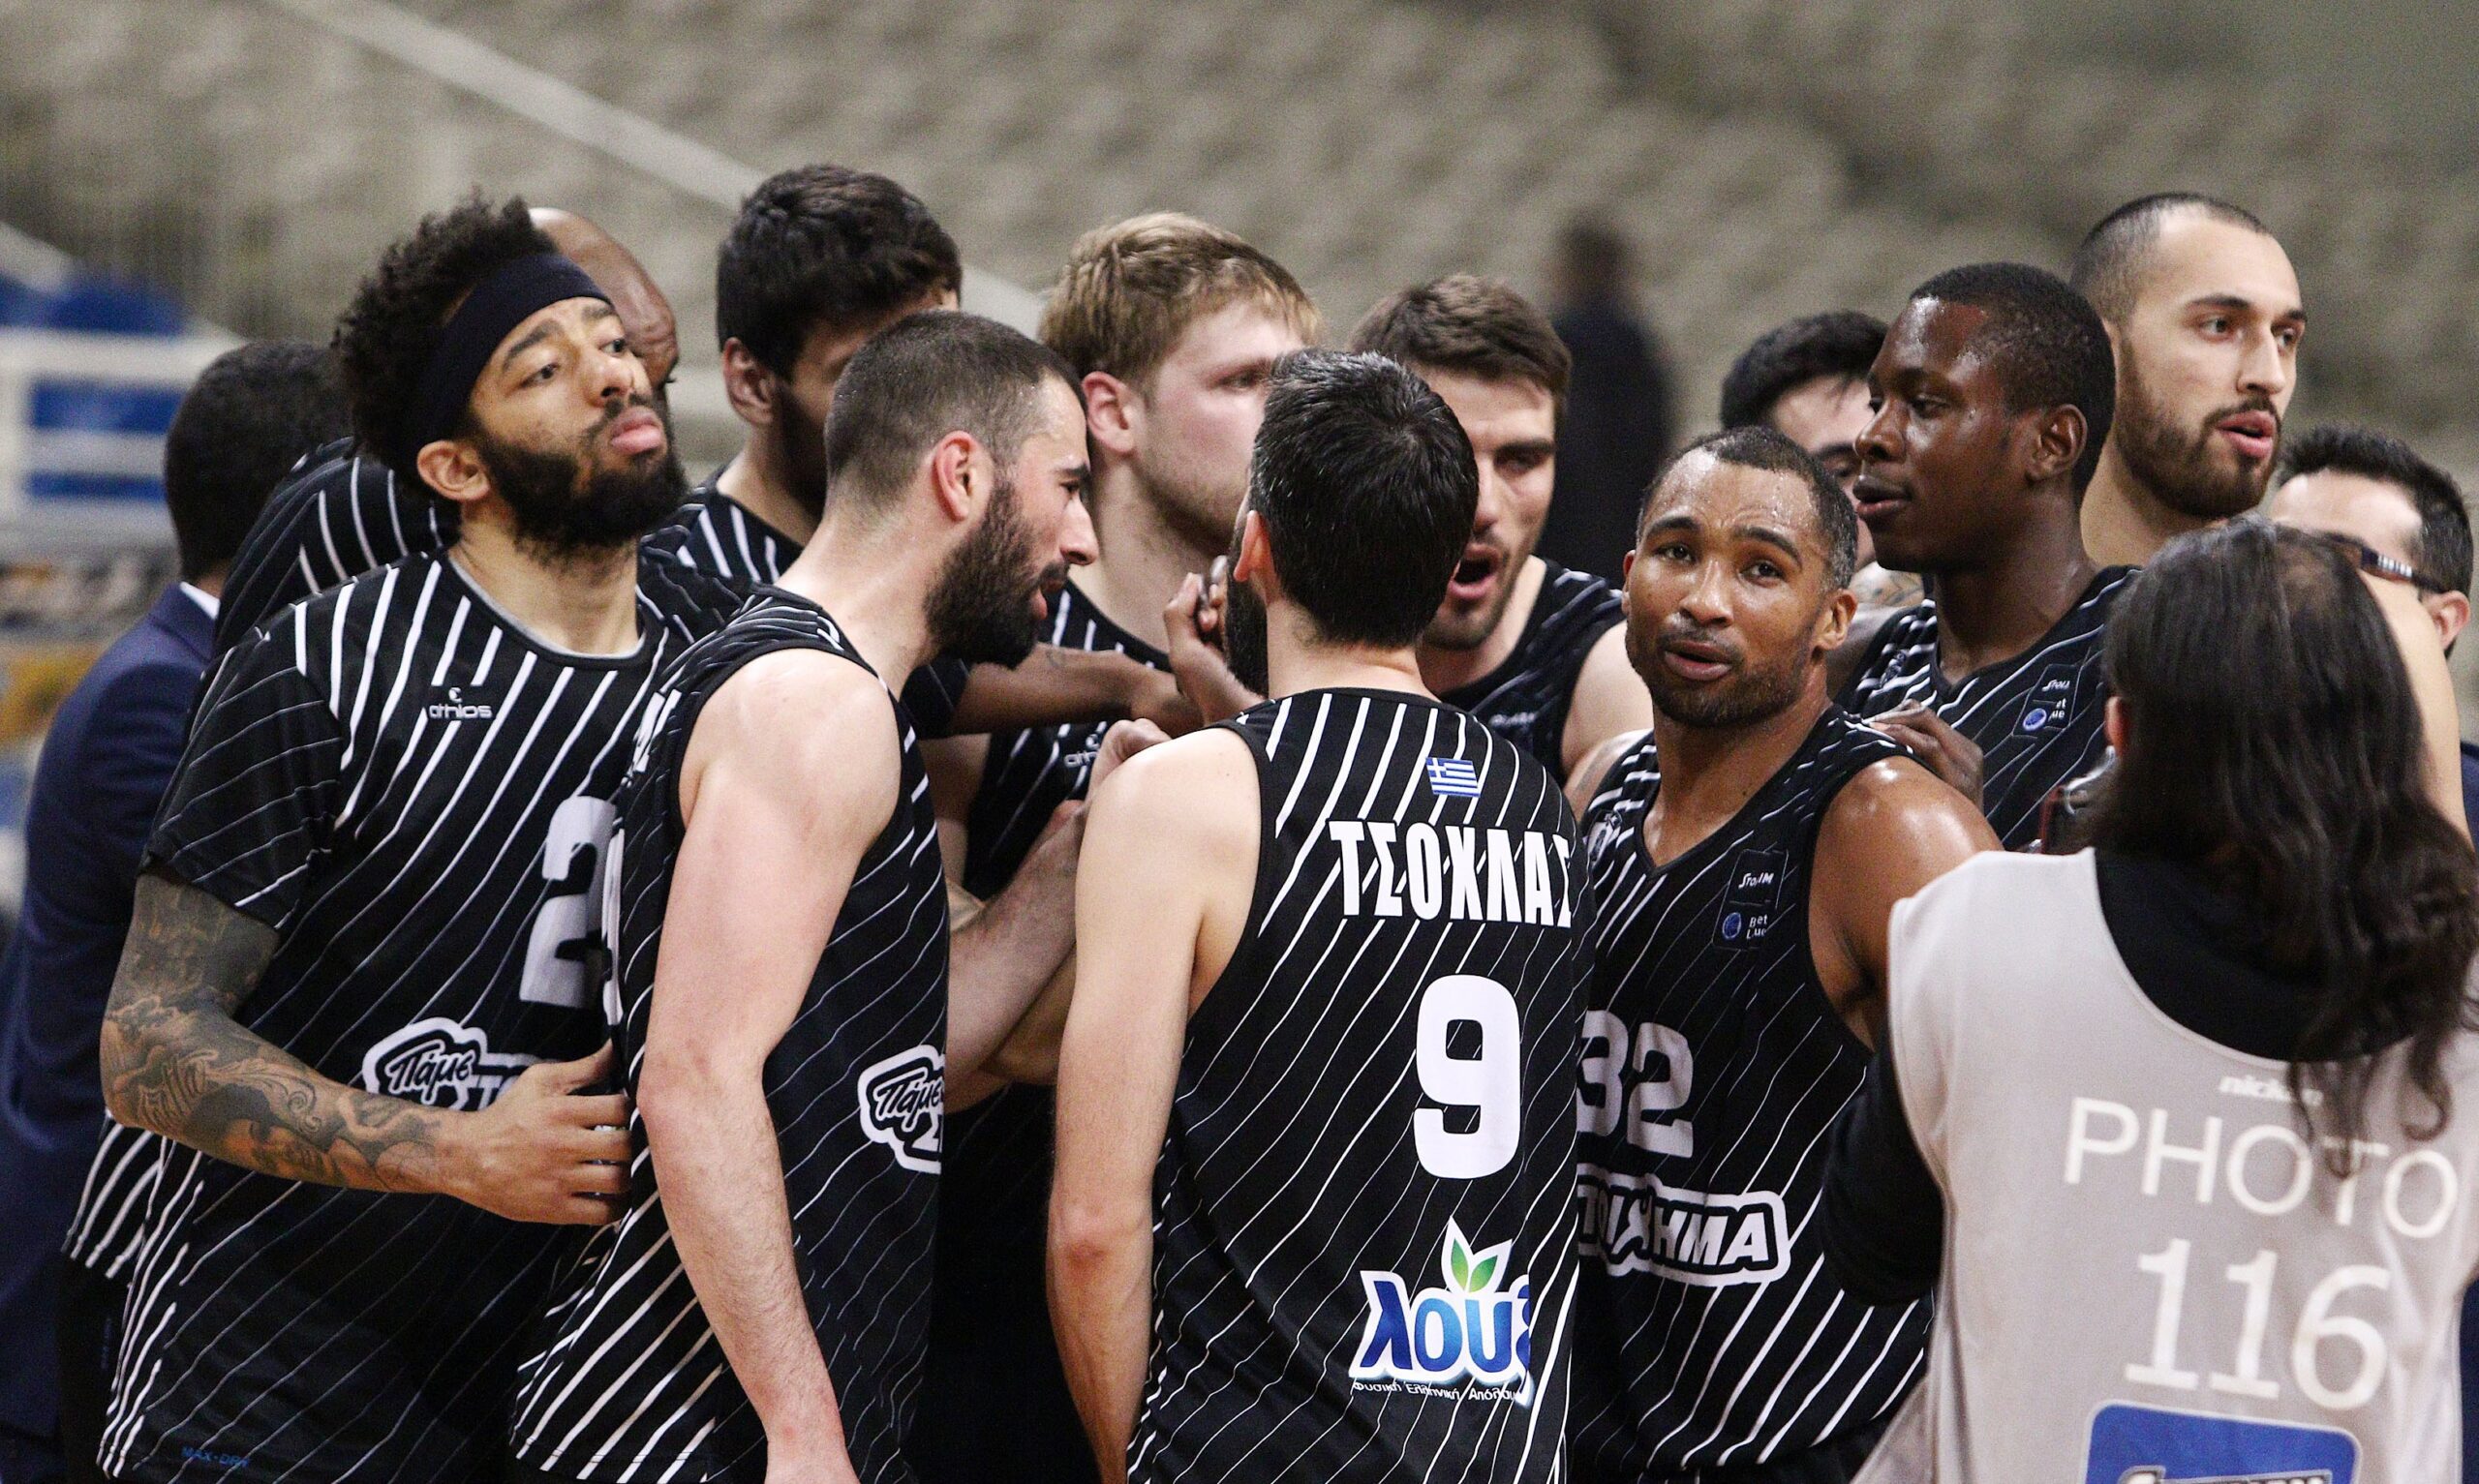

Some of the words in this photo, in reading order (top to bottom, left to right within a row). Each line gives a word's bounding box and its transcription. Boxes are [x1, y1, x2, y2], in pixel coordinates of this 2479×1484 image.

[1414, 974, 1520, 1179] 9
[1576, 1010, 1694, 1158] 32
[1577, 1184, 1770, 1266] ΤΟΙΧΗΜΑ
[2065, 1097, 2458, 1238] PHOTO
[2125, 1238, 2391, 1409] 116
